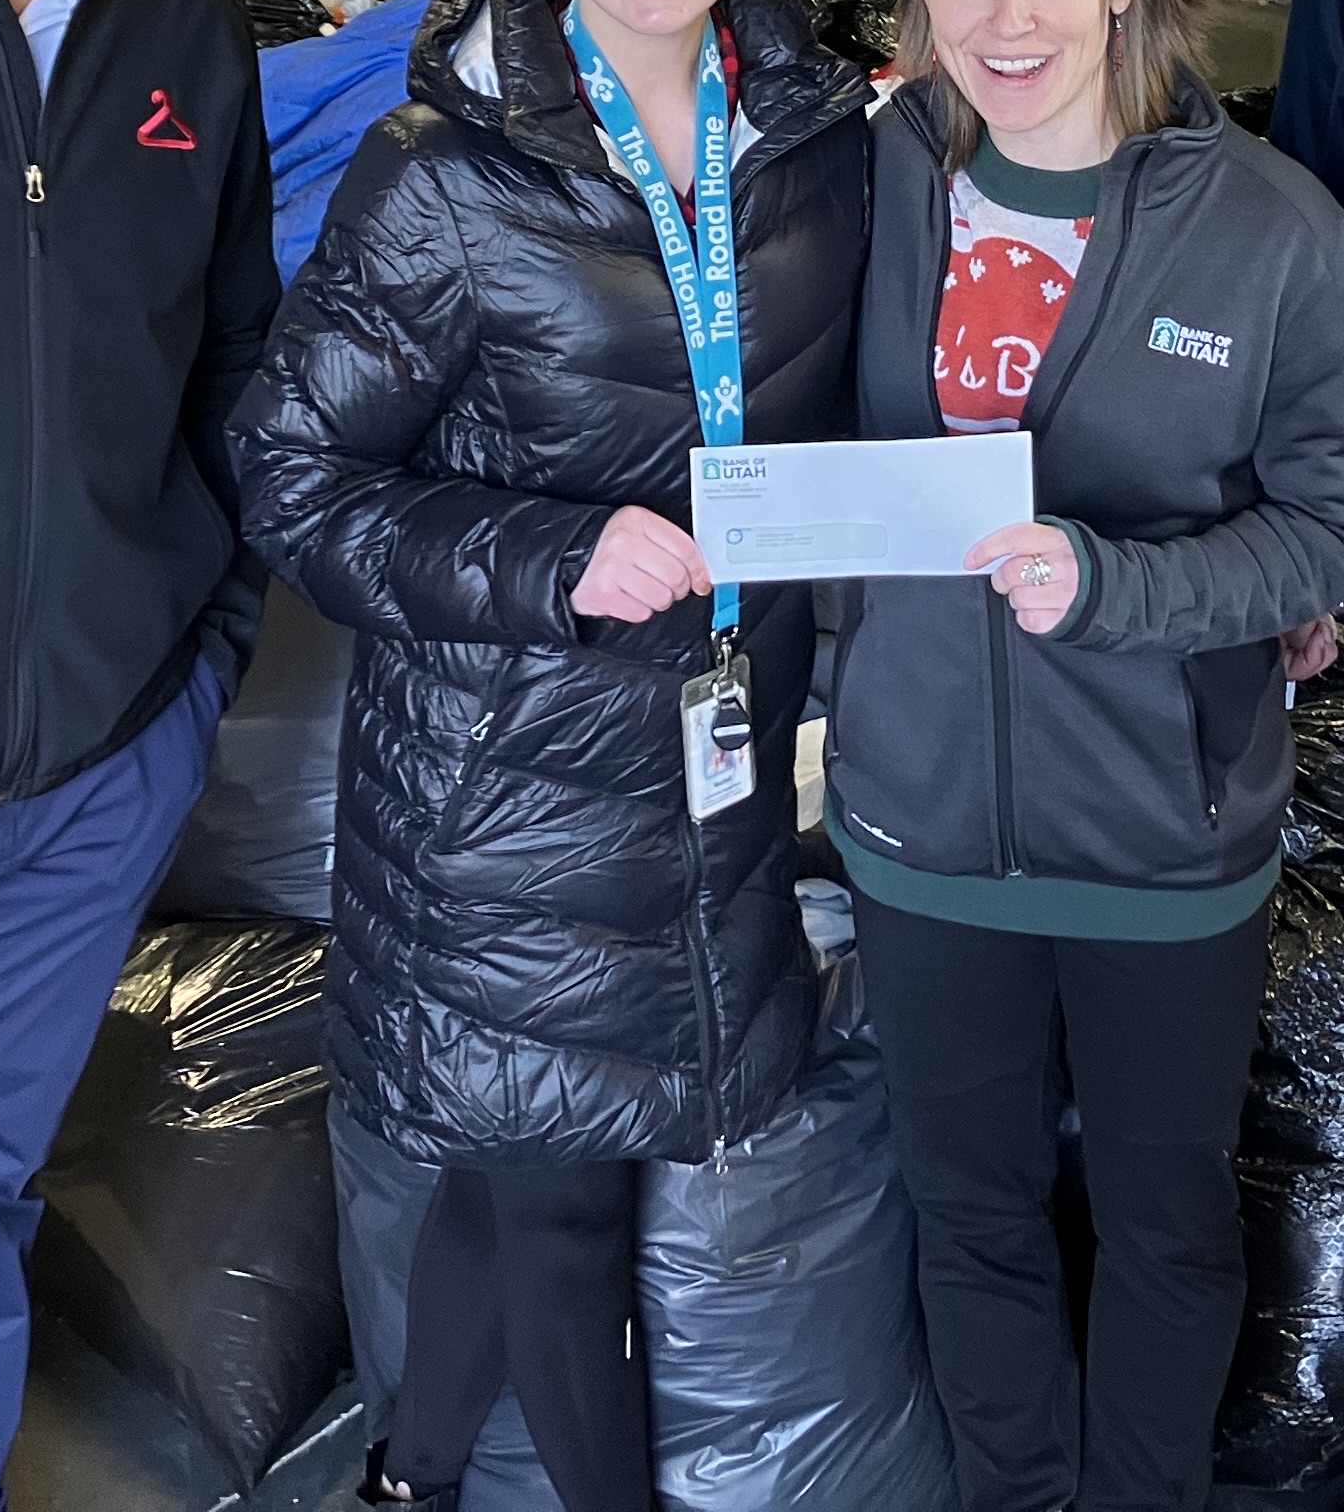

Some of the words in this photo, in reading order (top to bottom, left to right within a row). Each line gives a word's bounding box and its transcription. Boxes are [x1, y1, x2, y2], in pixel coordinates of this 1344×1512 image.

[700, 116, 725, 197] Home
[617, 126, 651, 177] The
[645, 181, 688, 257] Road
[671, 261, 705, 350] Home
[701, 207, 731, 282] Road
[710, 290, 734, 343] The
[1179, 326, 1214, 345] BANK
[1214, 335, 1233, 348] OF
[1176, 337, 1229, 367] UTAH
[723, 466, 766, 479] UTAH
